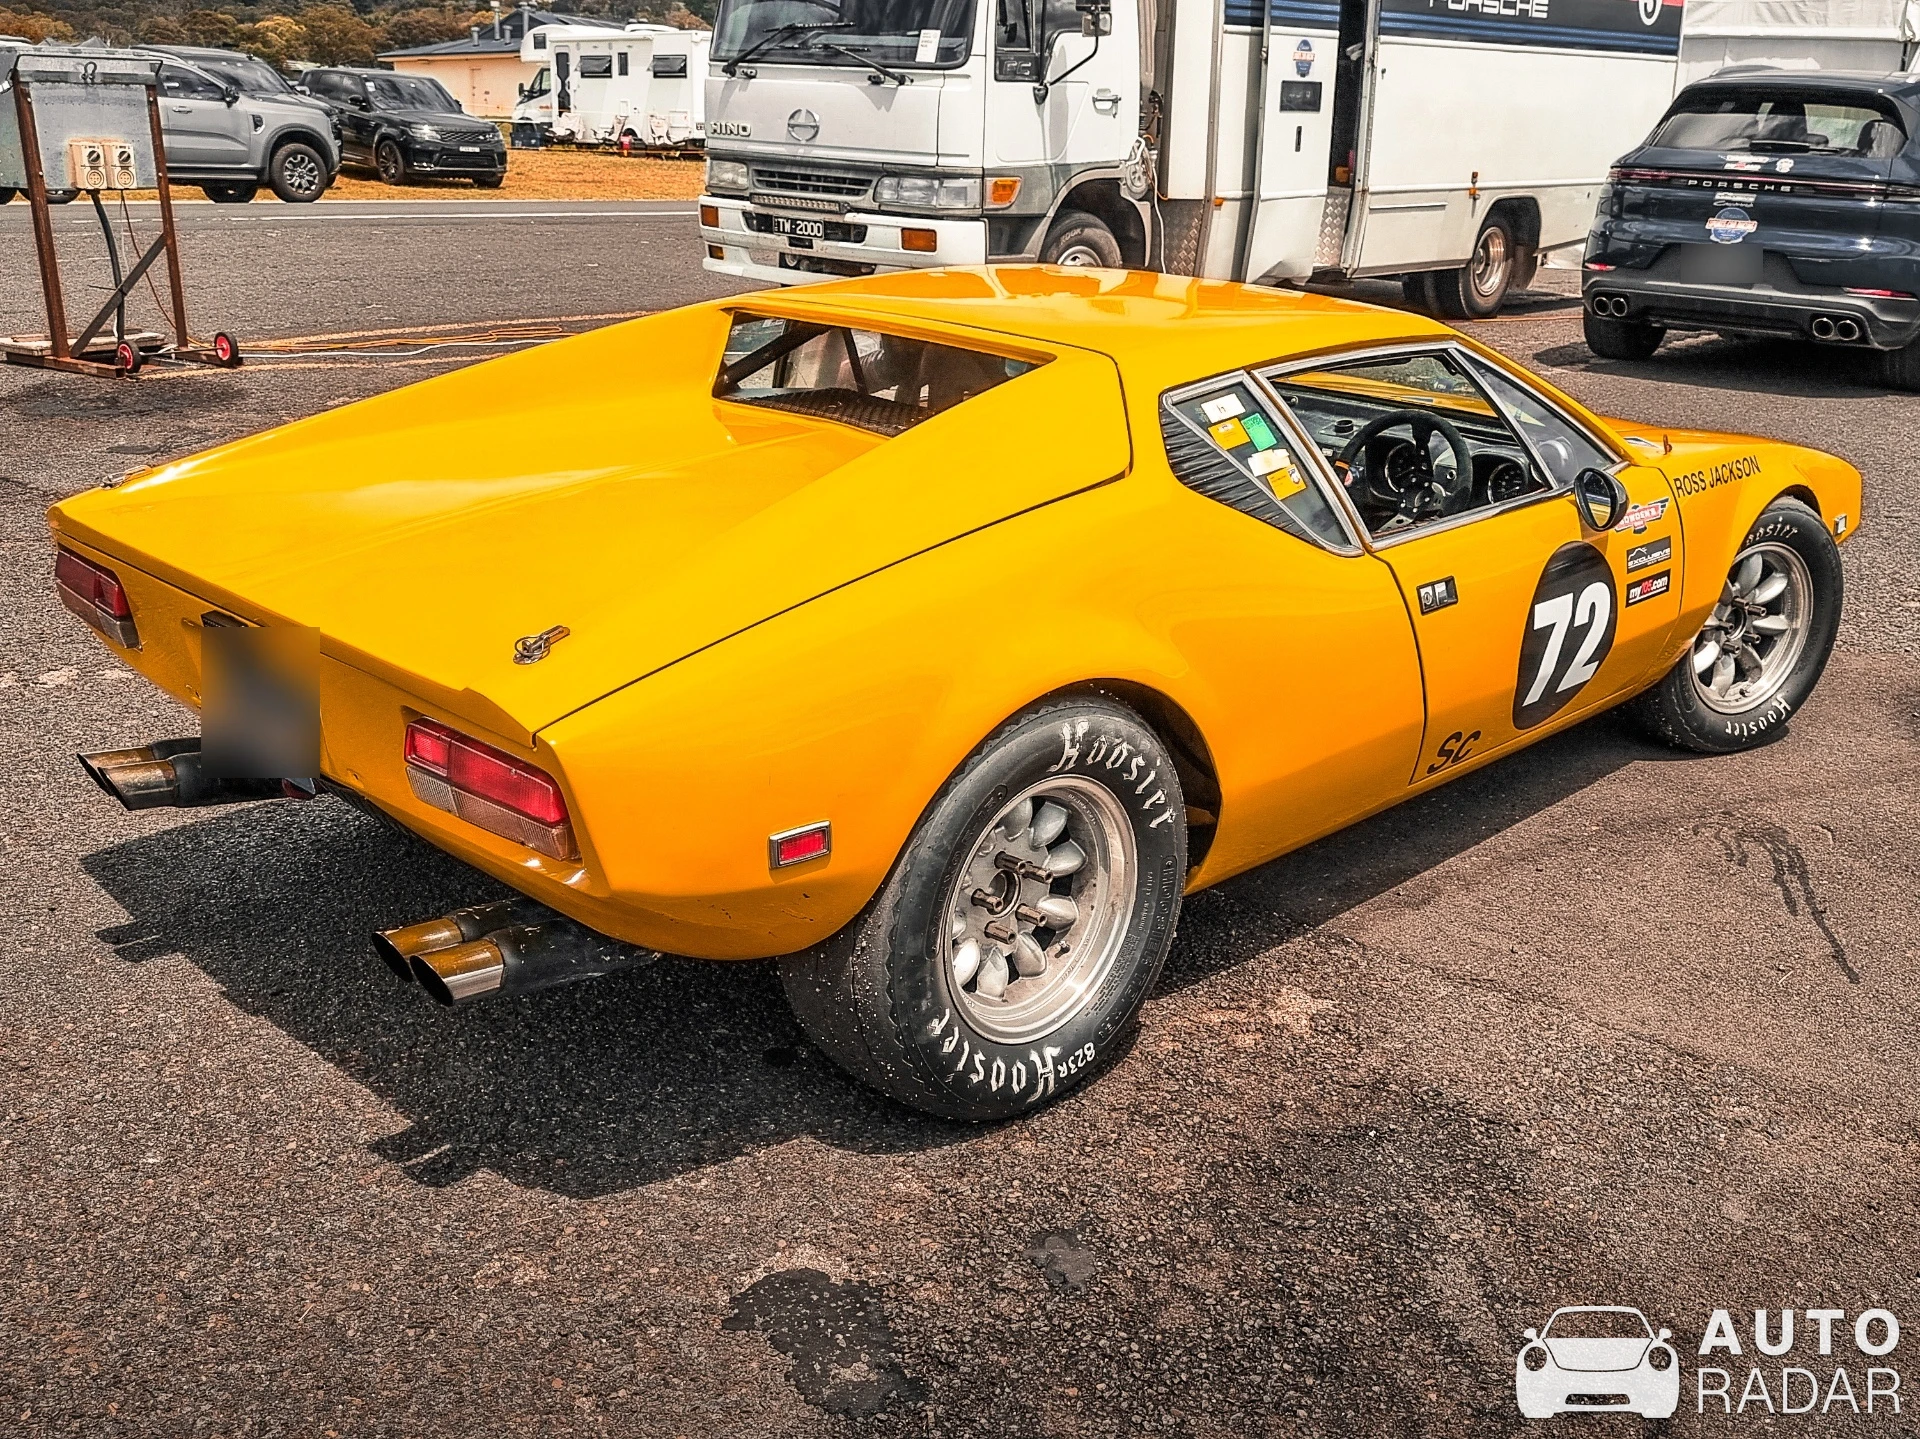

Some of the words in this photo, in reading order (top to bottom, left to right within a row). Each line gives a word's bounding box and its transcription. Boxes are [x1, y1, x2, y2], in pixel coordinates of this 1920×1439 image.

[710, 121, 751, 137] HINO
[1687, 179, 1792, 192] PORSCHE
[1673, 471, 1707, 498] ROSS
[1709, 455, 1762, 488] JACKSON
[1746, 516, 1798, 546] oosier
[1522, 581, 1611, 707] 72
[1725, 695, 1791, 742] Hoosier
[1427, 730, 1481, 774] SC
[1046, 720, 1177, 829] Hoosier
[928, 1008, 1062, 1104] Hoosier
